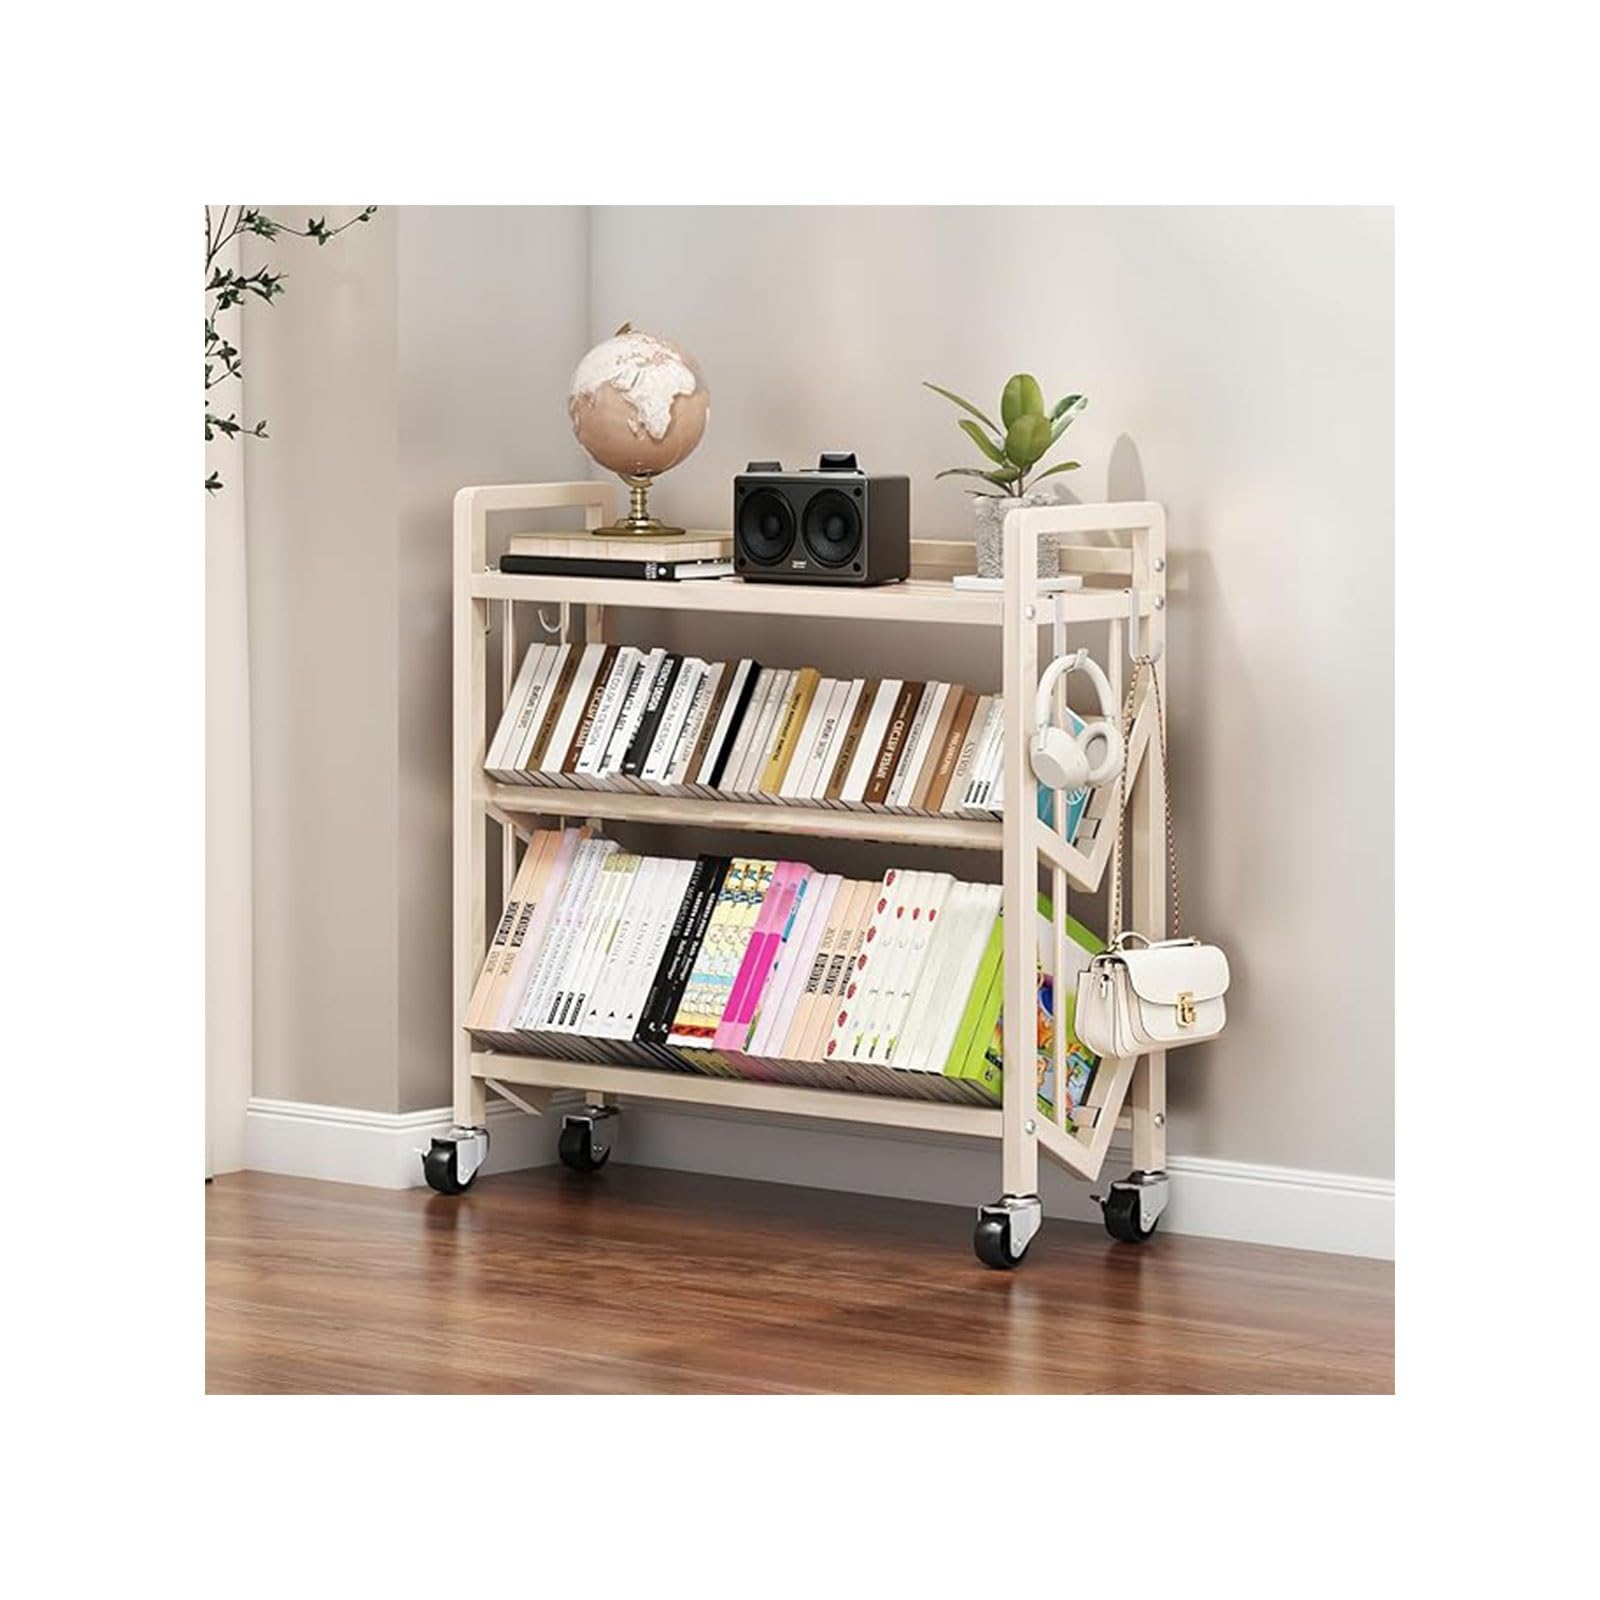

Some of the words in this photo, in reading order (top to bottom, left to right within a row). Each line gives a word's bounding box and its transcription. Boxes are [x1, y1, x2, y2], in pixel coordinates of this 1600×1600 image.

[603, 676, 621, 704] COLOR
[587, 712, 607, 747] DESIGN
[652, 720, 673, 754] DESIGN
